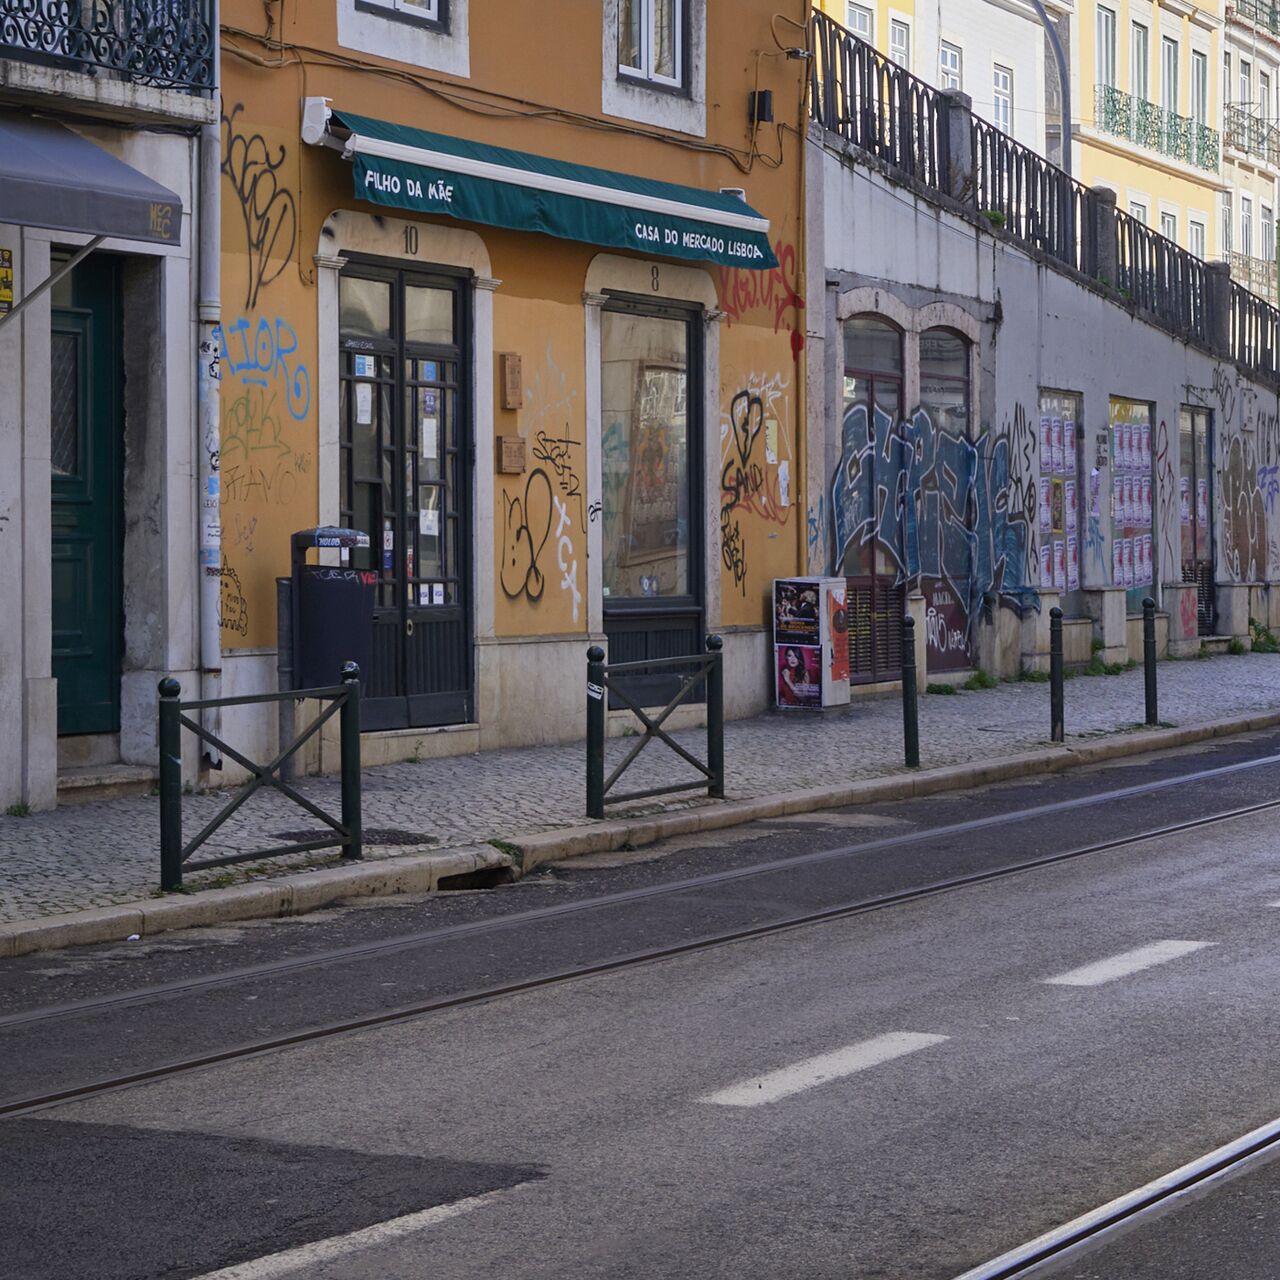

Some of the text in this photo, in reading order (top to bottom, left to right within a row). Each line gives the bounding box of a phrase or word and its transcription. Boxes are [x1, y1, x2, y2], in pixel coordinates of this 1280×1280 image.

[364, 169, 454, 203] FILHO DA MÃE
[402, 224, 419, 256] 10
[635, 223, 764, 260] CASA DO MERCADO LISBOA
[650, 265, 661, 292] 8
